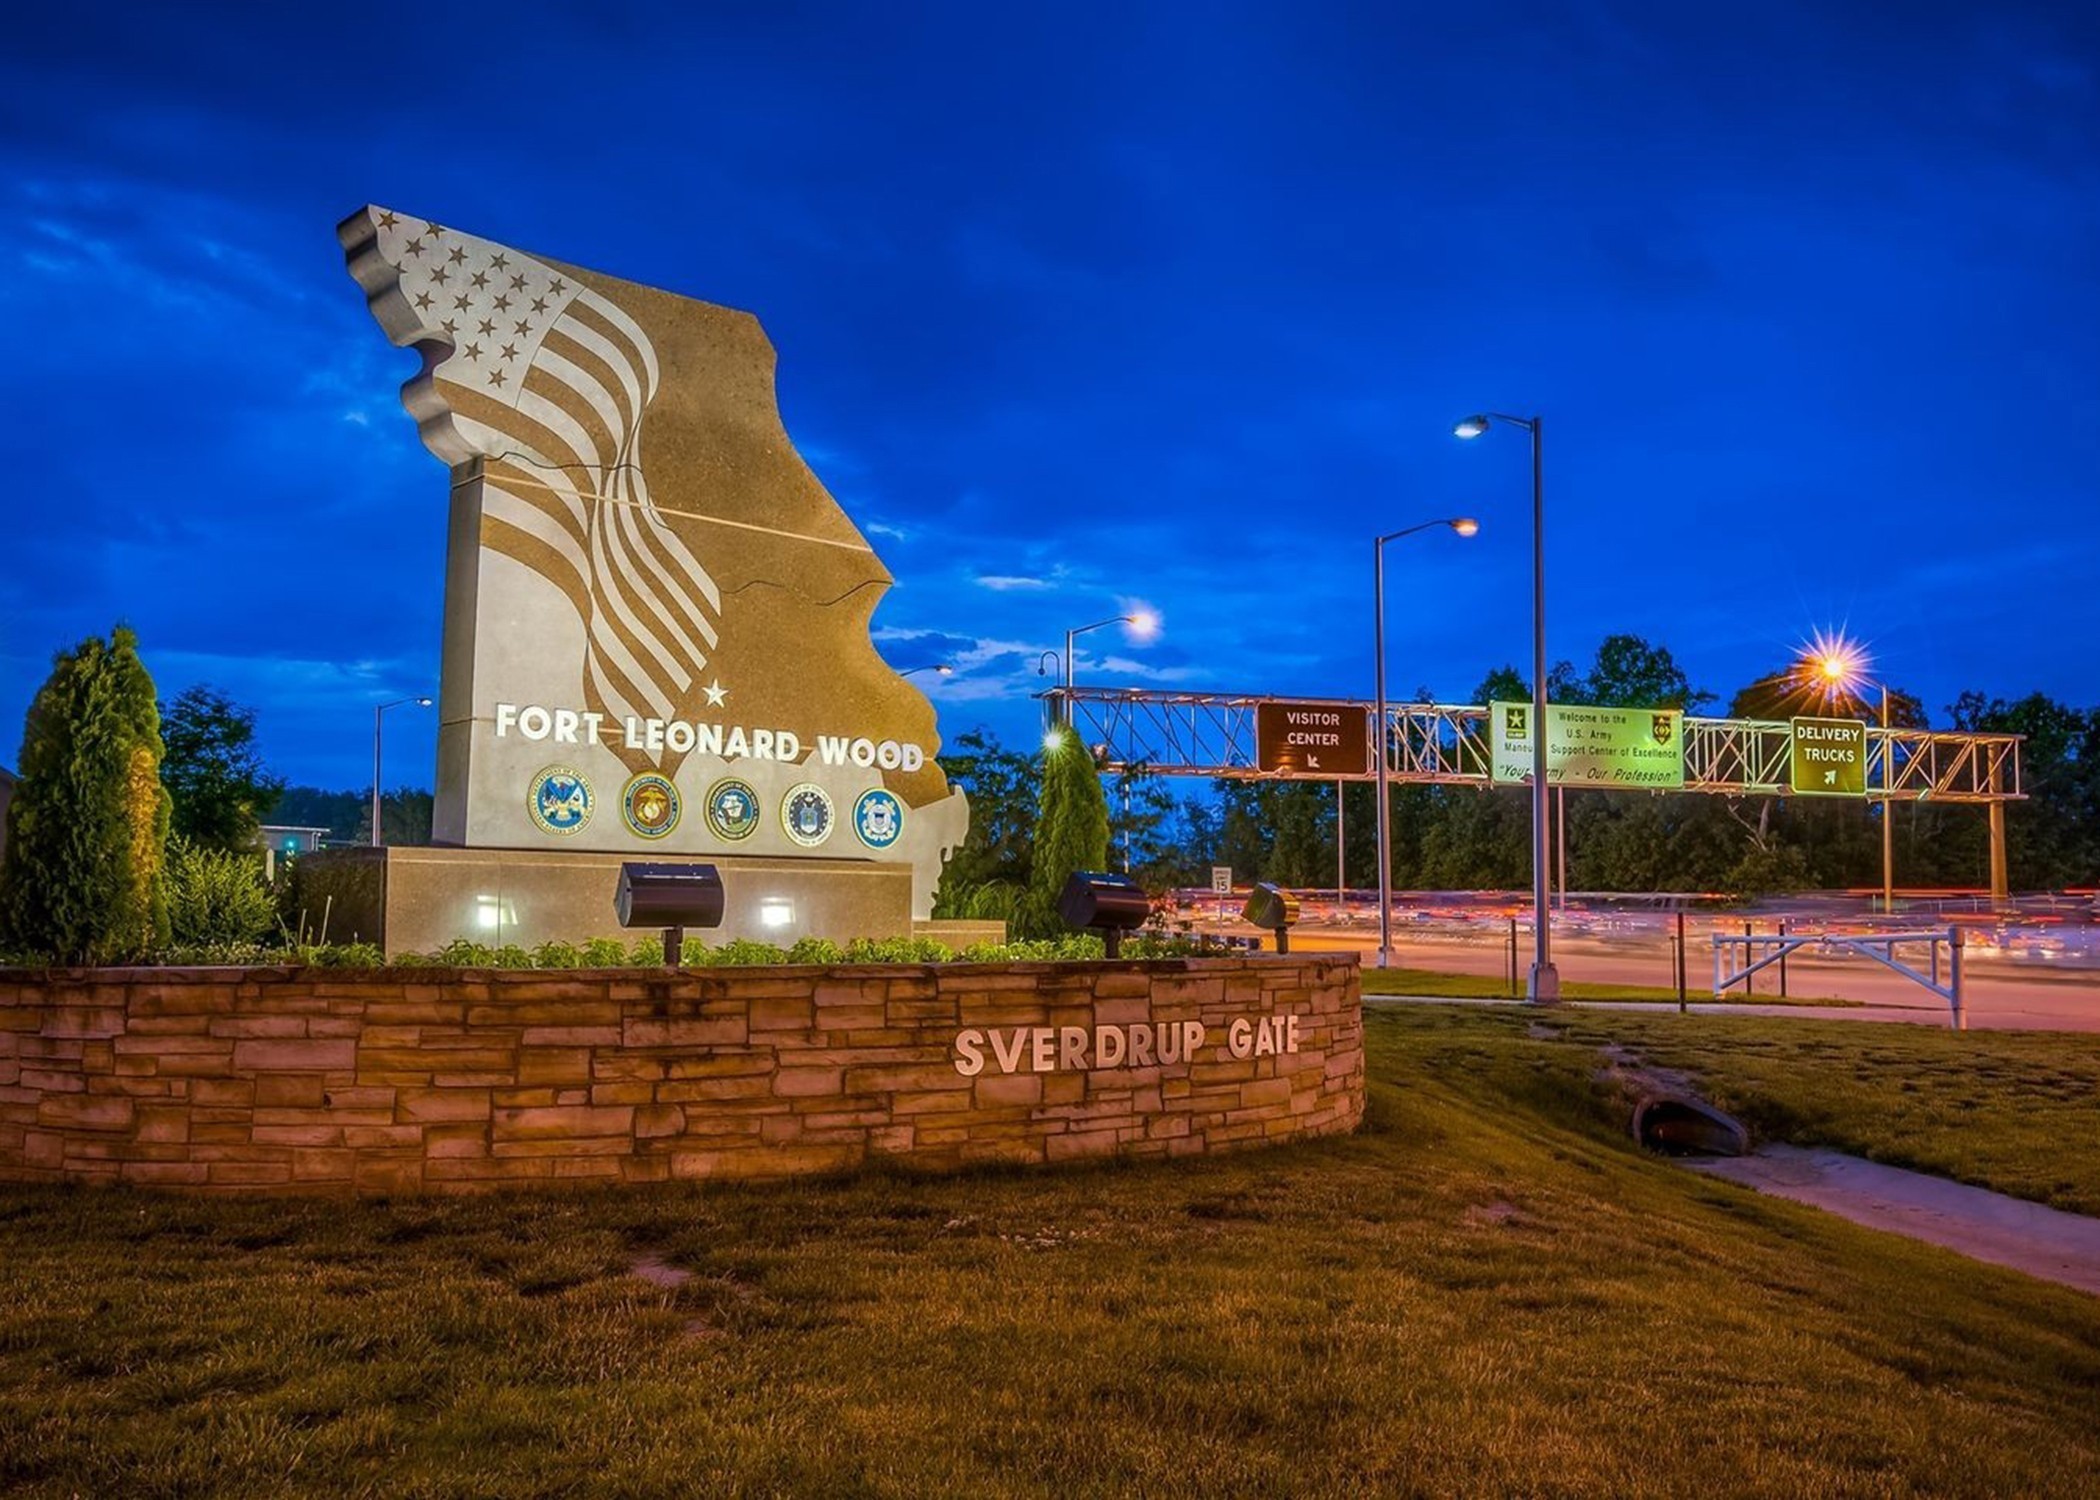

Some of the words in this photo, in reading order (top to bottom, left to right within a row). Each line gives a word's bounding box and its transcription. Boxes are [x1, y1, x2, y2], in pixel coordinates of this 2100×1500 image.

[1287, 712, 1340, 726] VISITOR
[1559, 712, 1597, 723] Welcome
[1600, 714, 1609, 724] to
[1613, 714, 1626, 724] the
[496, 704, 603, 745] FORT
[625, 716, 800, 762] LEONARD
[818, 735, 924, 773] WOOD
[1287, 732, 1339, 746] CENTER
[1566, 729, 1584, 738] U.S.
[1590, 730, 1612, 742] Army
[1797, 726, 1860, 742] DELIVERY
[1504, 742, 1533, 753] Maneu
[1551, 744, 1585, 757] Support
[1589, 746, 1617, 756] Center
[1620, 748, 1629, 757] of
[1633, 747, 1677, 758] Excellence
[1804, 747, 1855, 762] TRUCKS
[1587, 767, 1608, 780] Our
[1216, 881, 1228, 891] 15
[954, 1021, 1206, 1076] SVERDRUP
[1228, 1015, 1299, 1059] GATE
